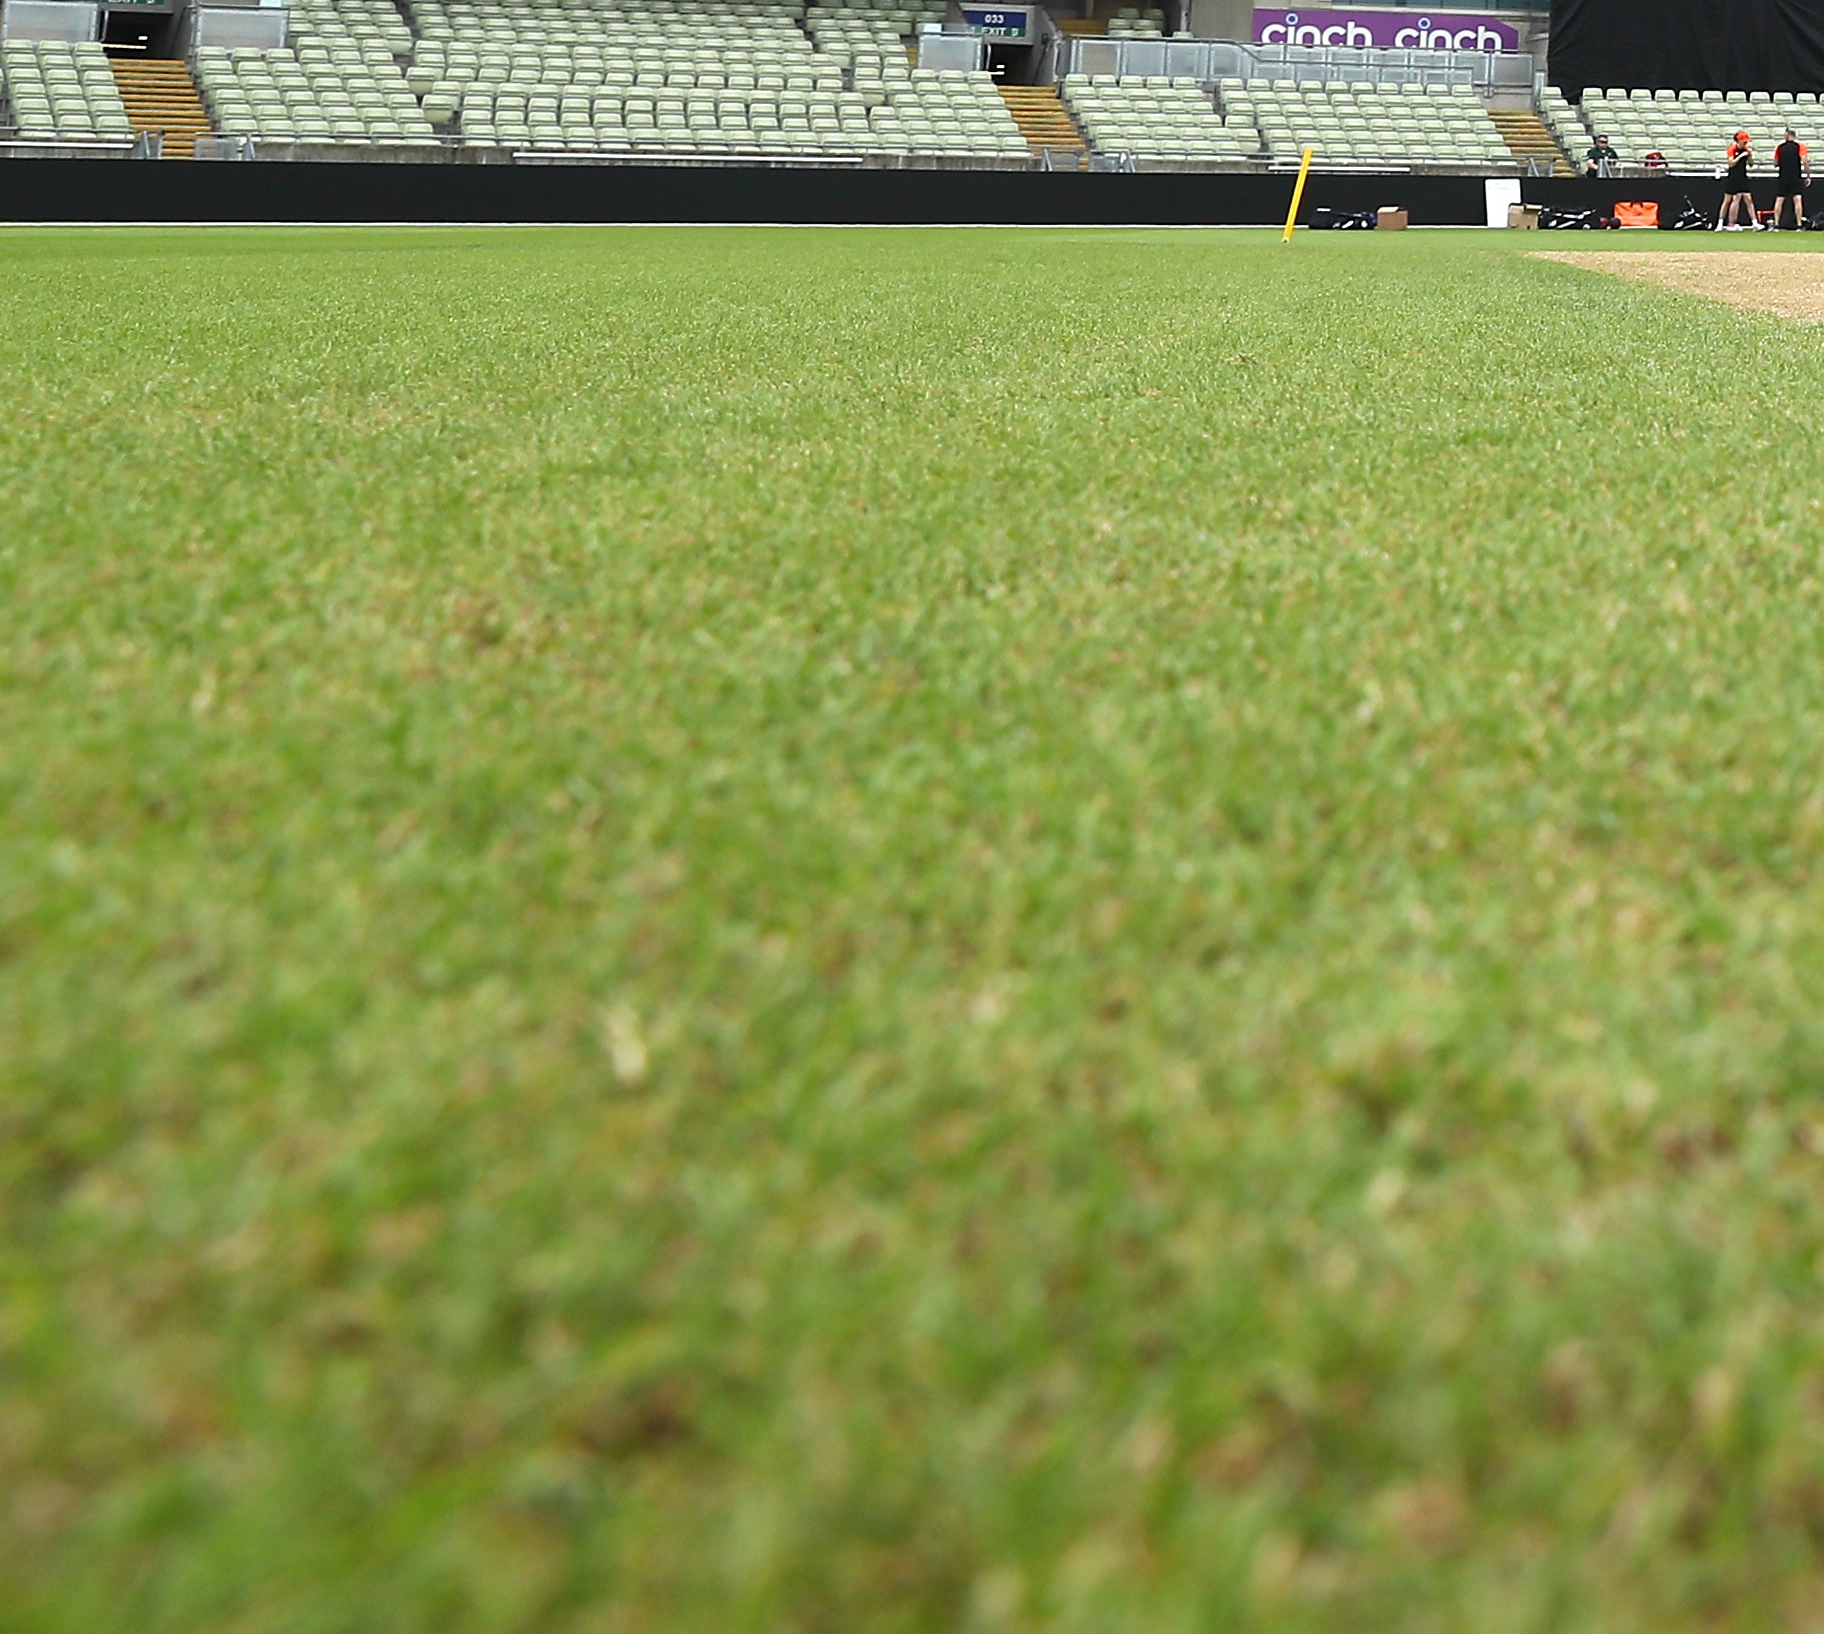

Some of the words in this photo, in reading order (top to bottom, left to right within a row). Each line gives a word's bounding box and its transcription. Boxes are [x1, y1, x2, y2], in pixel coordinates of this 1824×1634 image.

[985, 14, 1004, 24] 033
[980, 26, 1006, 36] EXIT
[1262, 14, 1372, 47] cinch
[1395, 18, 1501, 50] cinch
